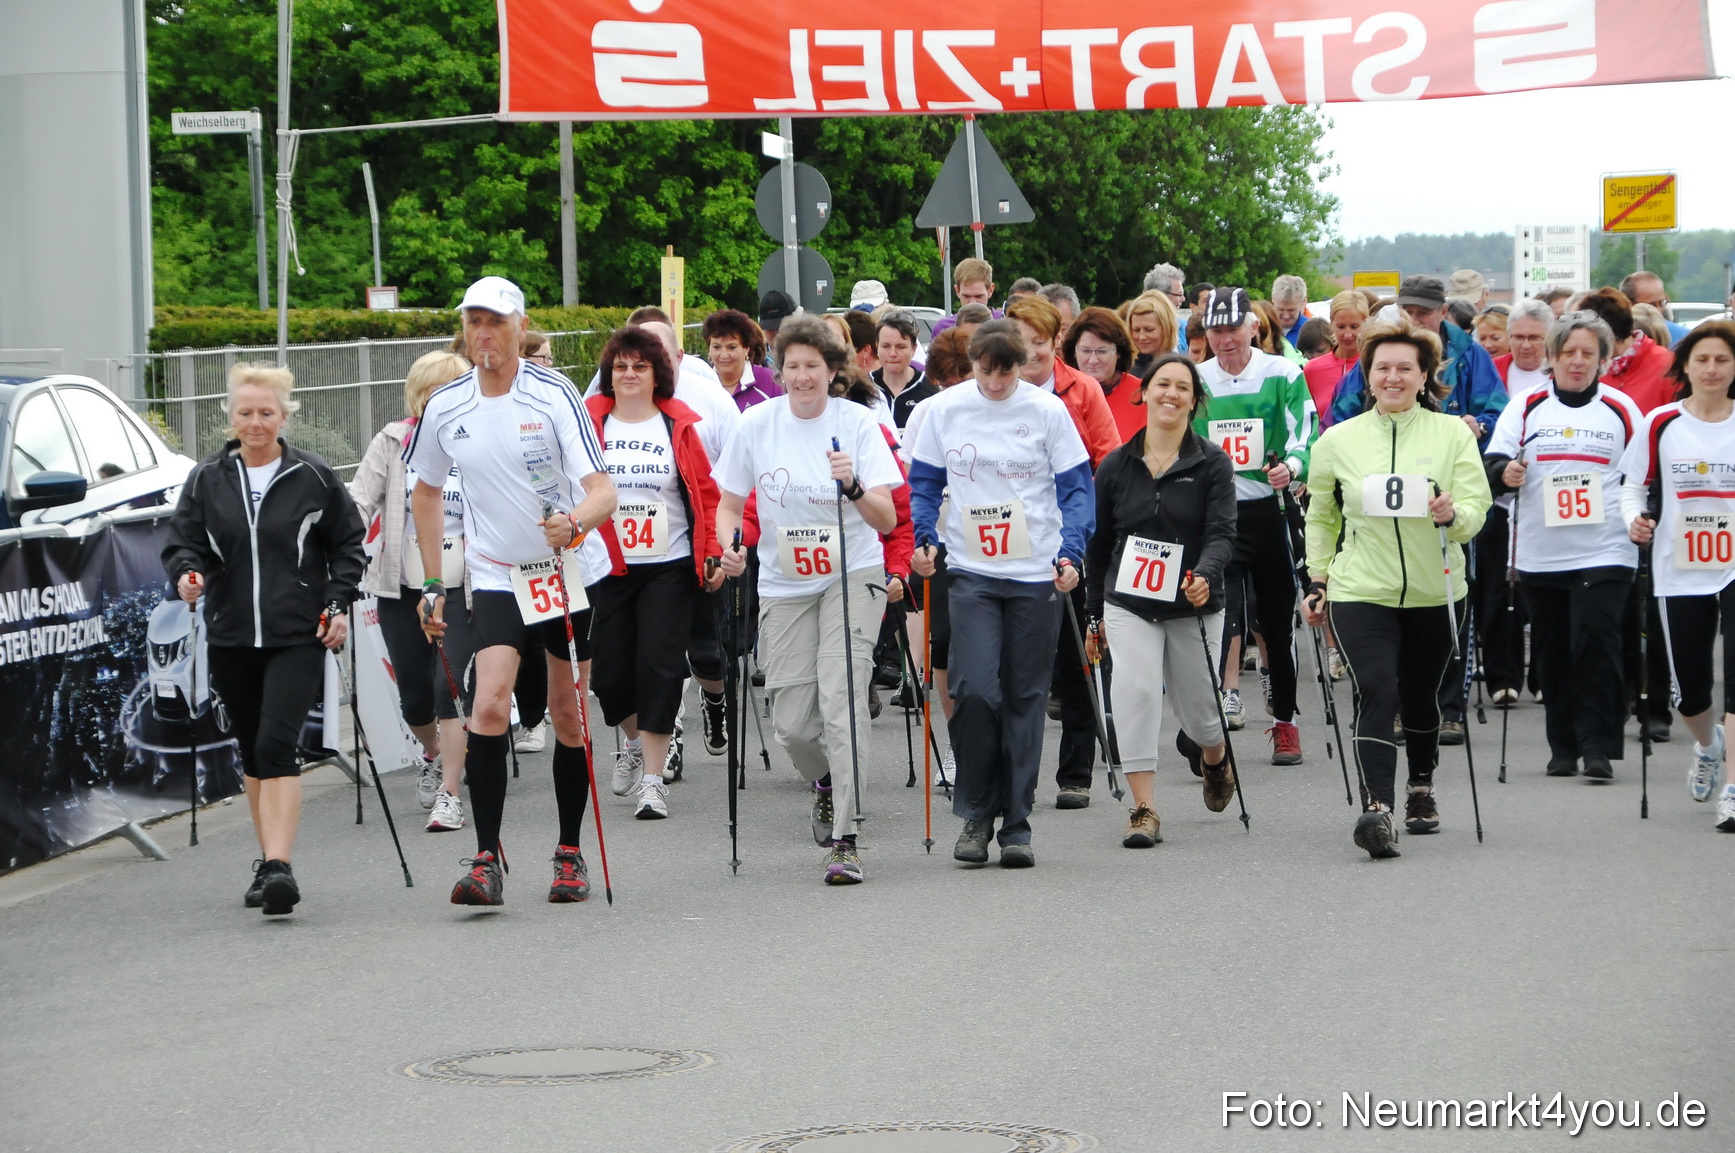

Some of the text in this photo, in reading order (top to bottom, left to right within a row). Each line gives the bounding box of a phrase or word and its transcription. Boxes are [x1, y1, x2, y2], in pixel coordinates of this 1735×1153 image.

[178, 115, 246, 129] Weichselberg
[1610, 181, 1671, 199] Sengenthal
[1216, 421, 1242, 429] MEYER
[1221, 435, 1250, 465] 45
[606, 463, 670, 475] ER GIRLS
[950, 458, 967, 467] Herz
[977, 458, 999, 469] Sport
[1552, 474, 1579, 483] MEYER
[635, 482, 661, 492] talking
[763, 482, 780, 491] Herz
[789, 483, 813, 493] Sport
[1385, 475, 1404, 511] 8
[619, 504, 646, 512] MEYER
[1557, 488, 1591, 519] 95
[970, 507, 999, 516] MEYER
[622, 517, 655, 549] 34
[786, 529, 816, 537] MEYER
[978, 522, 1011, 557] 57
[1134, 540, 1159, 551] MEYER
[1133, 547, 1159, 556] WERBUNG
[1684, 530, 1733, 563] 100
[520, 560, 551, 572] MEYER
[793, 546, 832, 576] 56
[520, 566, 553, 578] WERBUNG
[1132, 555, 1166, 592] 70
[528, 573, 566, 614] 53
[30, 614, 110, 658] ENTDECKEN.
